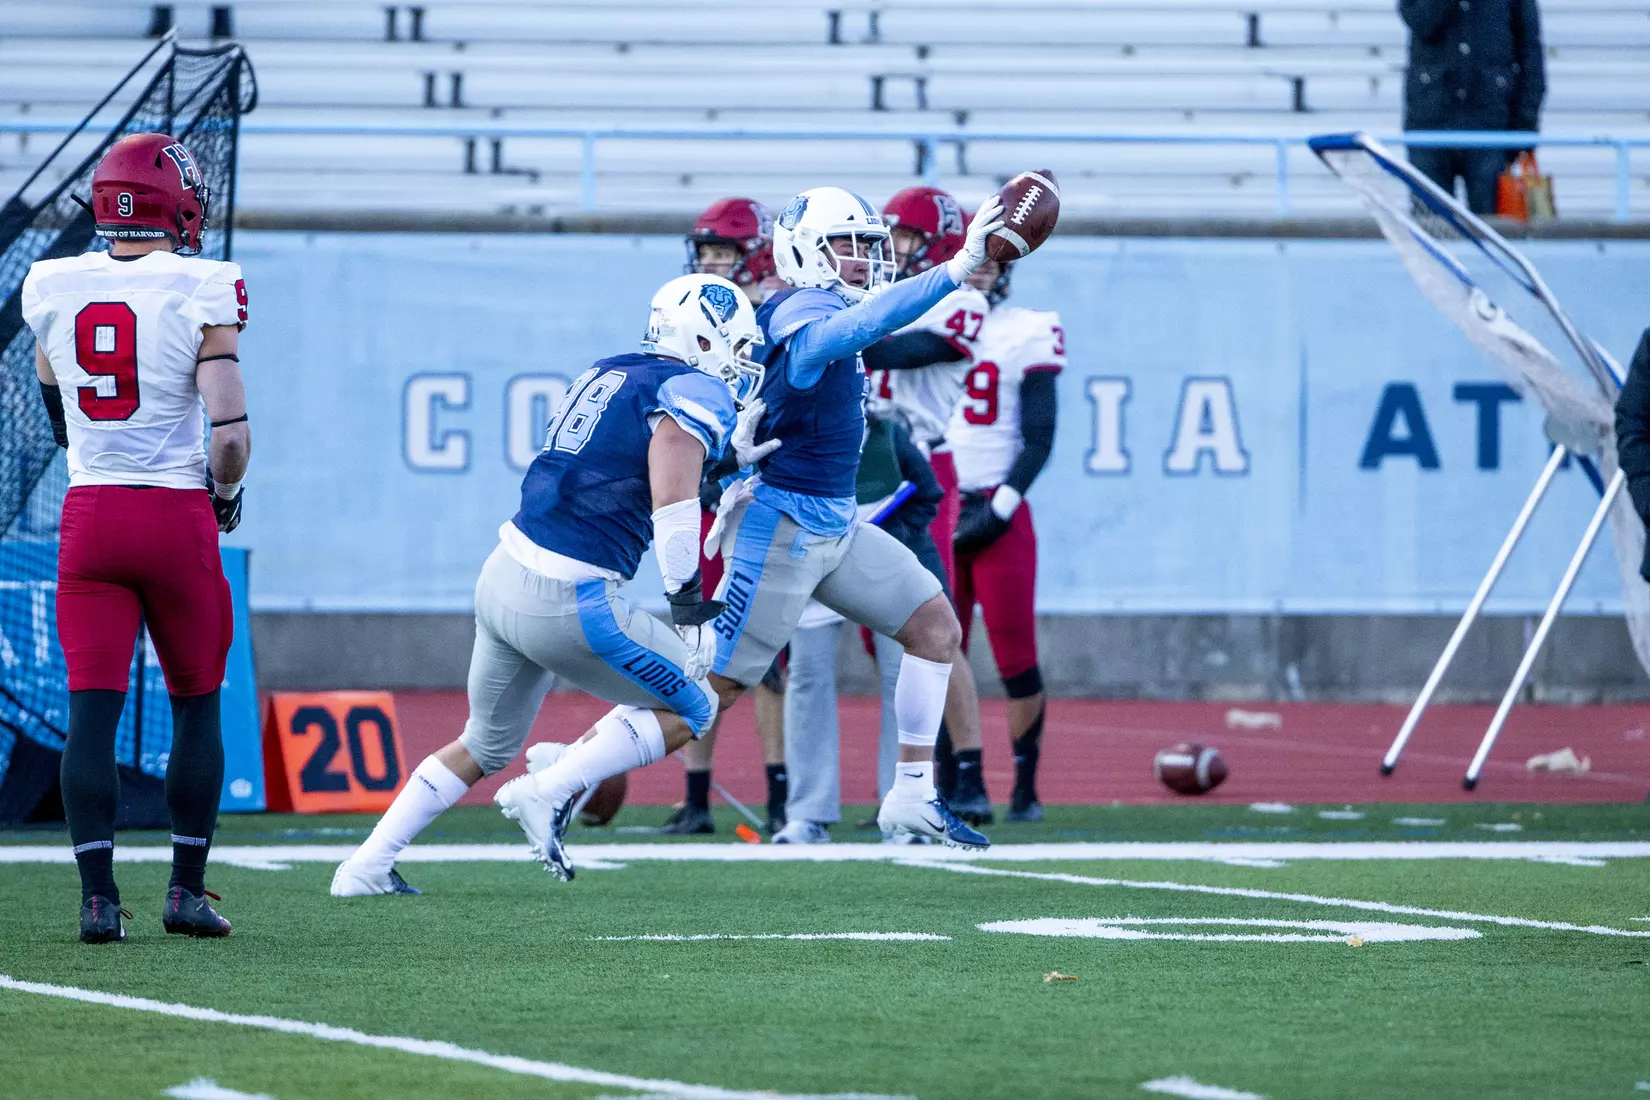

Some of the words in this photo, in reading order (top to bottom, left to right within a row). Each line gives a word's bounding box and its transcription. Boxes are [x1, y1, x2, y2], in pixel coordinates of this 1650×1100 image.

[162, 143, 202, 190] H
[117, 192, 134, 217] 9
[118, 230, 129, 238] OF
[234, 278, 249, 321] 9
[945, 309, 984, 342] 47
[75, 301, 141, 421] 9
[963, 360, 999, 426] 9
[713, 570, 754, 641] LIONS
[621, 653, 687, 697] LIONS
[290, 706, 401, 793] 20
